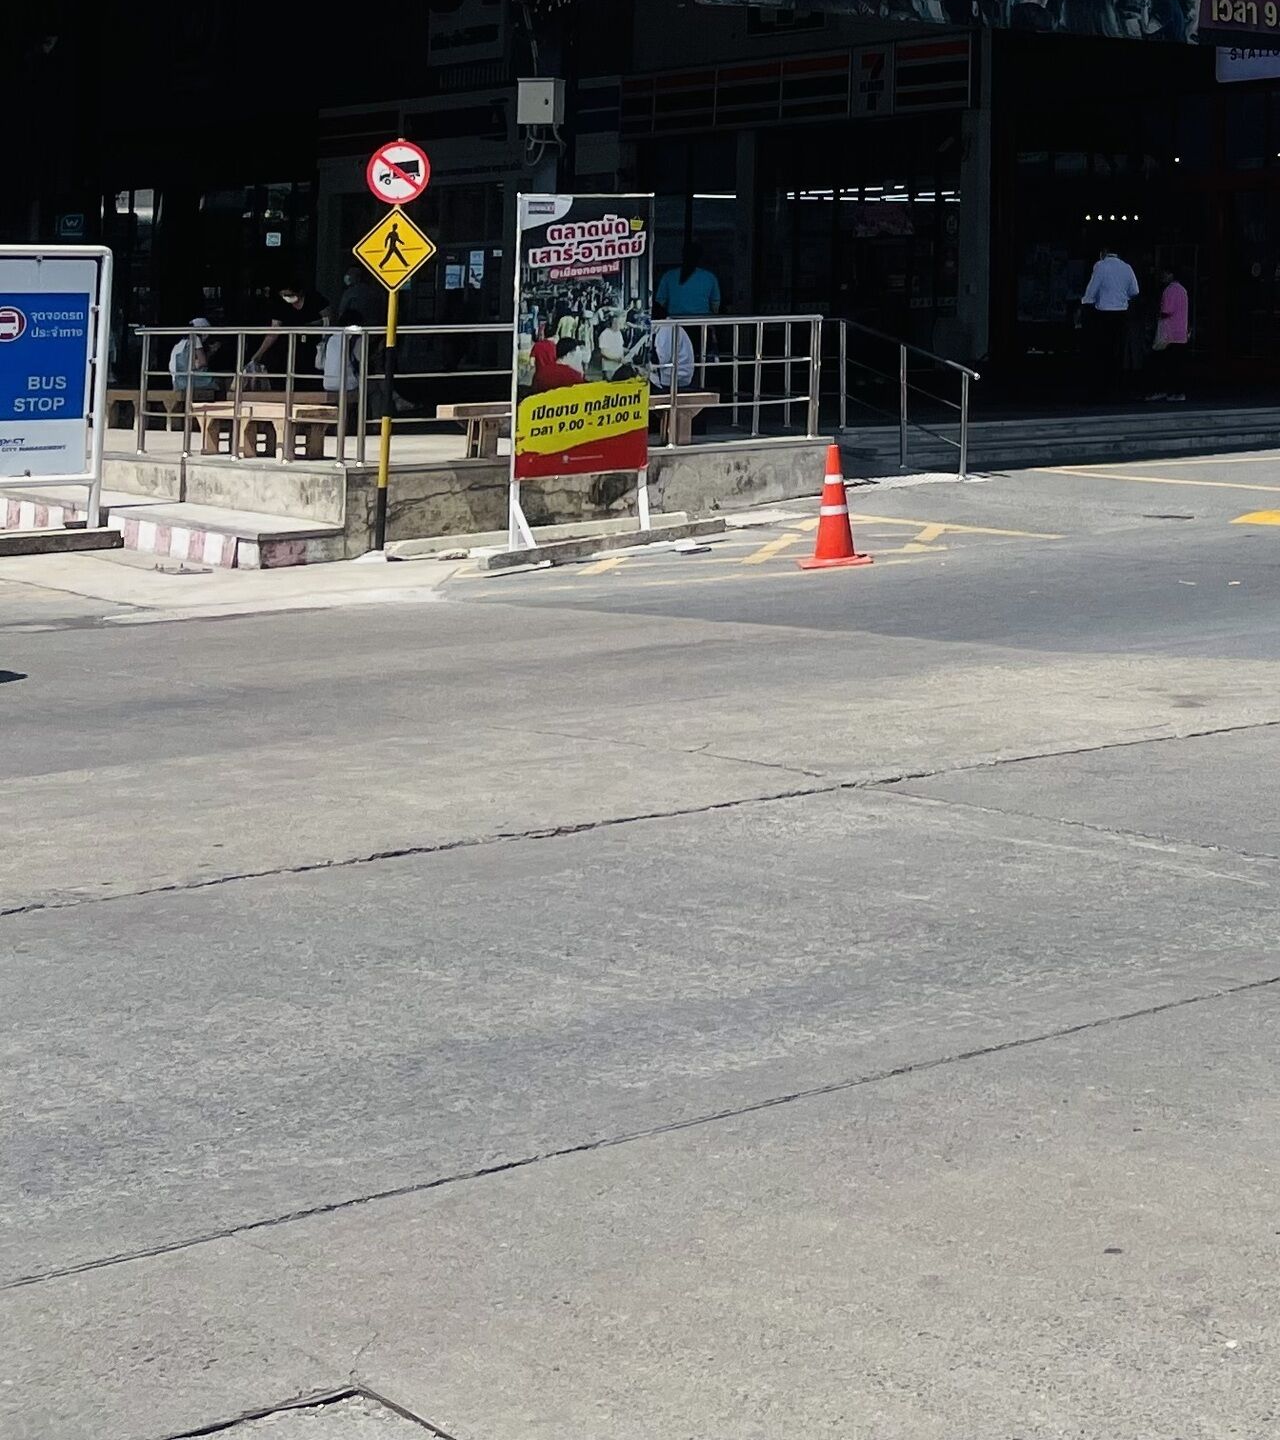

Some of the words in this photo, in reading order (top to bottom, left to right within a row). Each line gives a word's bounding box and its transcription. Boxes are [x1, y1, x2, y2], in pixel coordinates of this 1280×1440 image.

[550, 217, 627, 240] ตลาดนัด
[531, 235, 643, 264] เสาร์-อาทิตย์
[30, 311, 84, 323] จุดจอดรถ
[30, 326, 84, 339] ประจำทาง
[28, 375, 67, 391] BUS
[13, 397, 66, 413] STOP
[531, 403, 579, 421] เปิดขาย
[584, 390, 643, 415] ทุกสัปดาห์
[530, 425, 553, 437] เวลา
[558, 418, 585, 433] 9.00
[597, 411, 629, 427] 21.00
